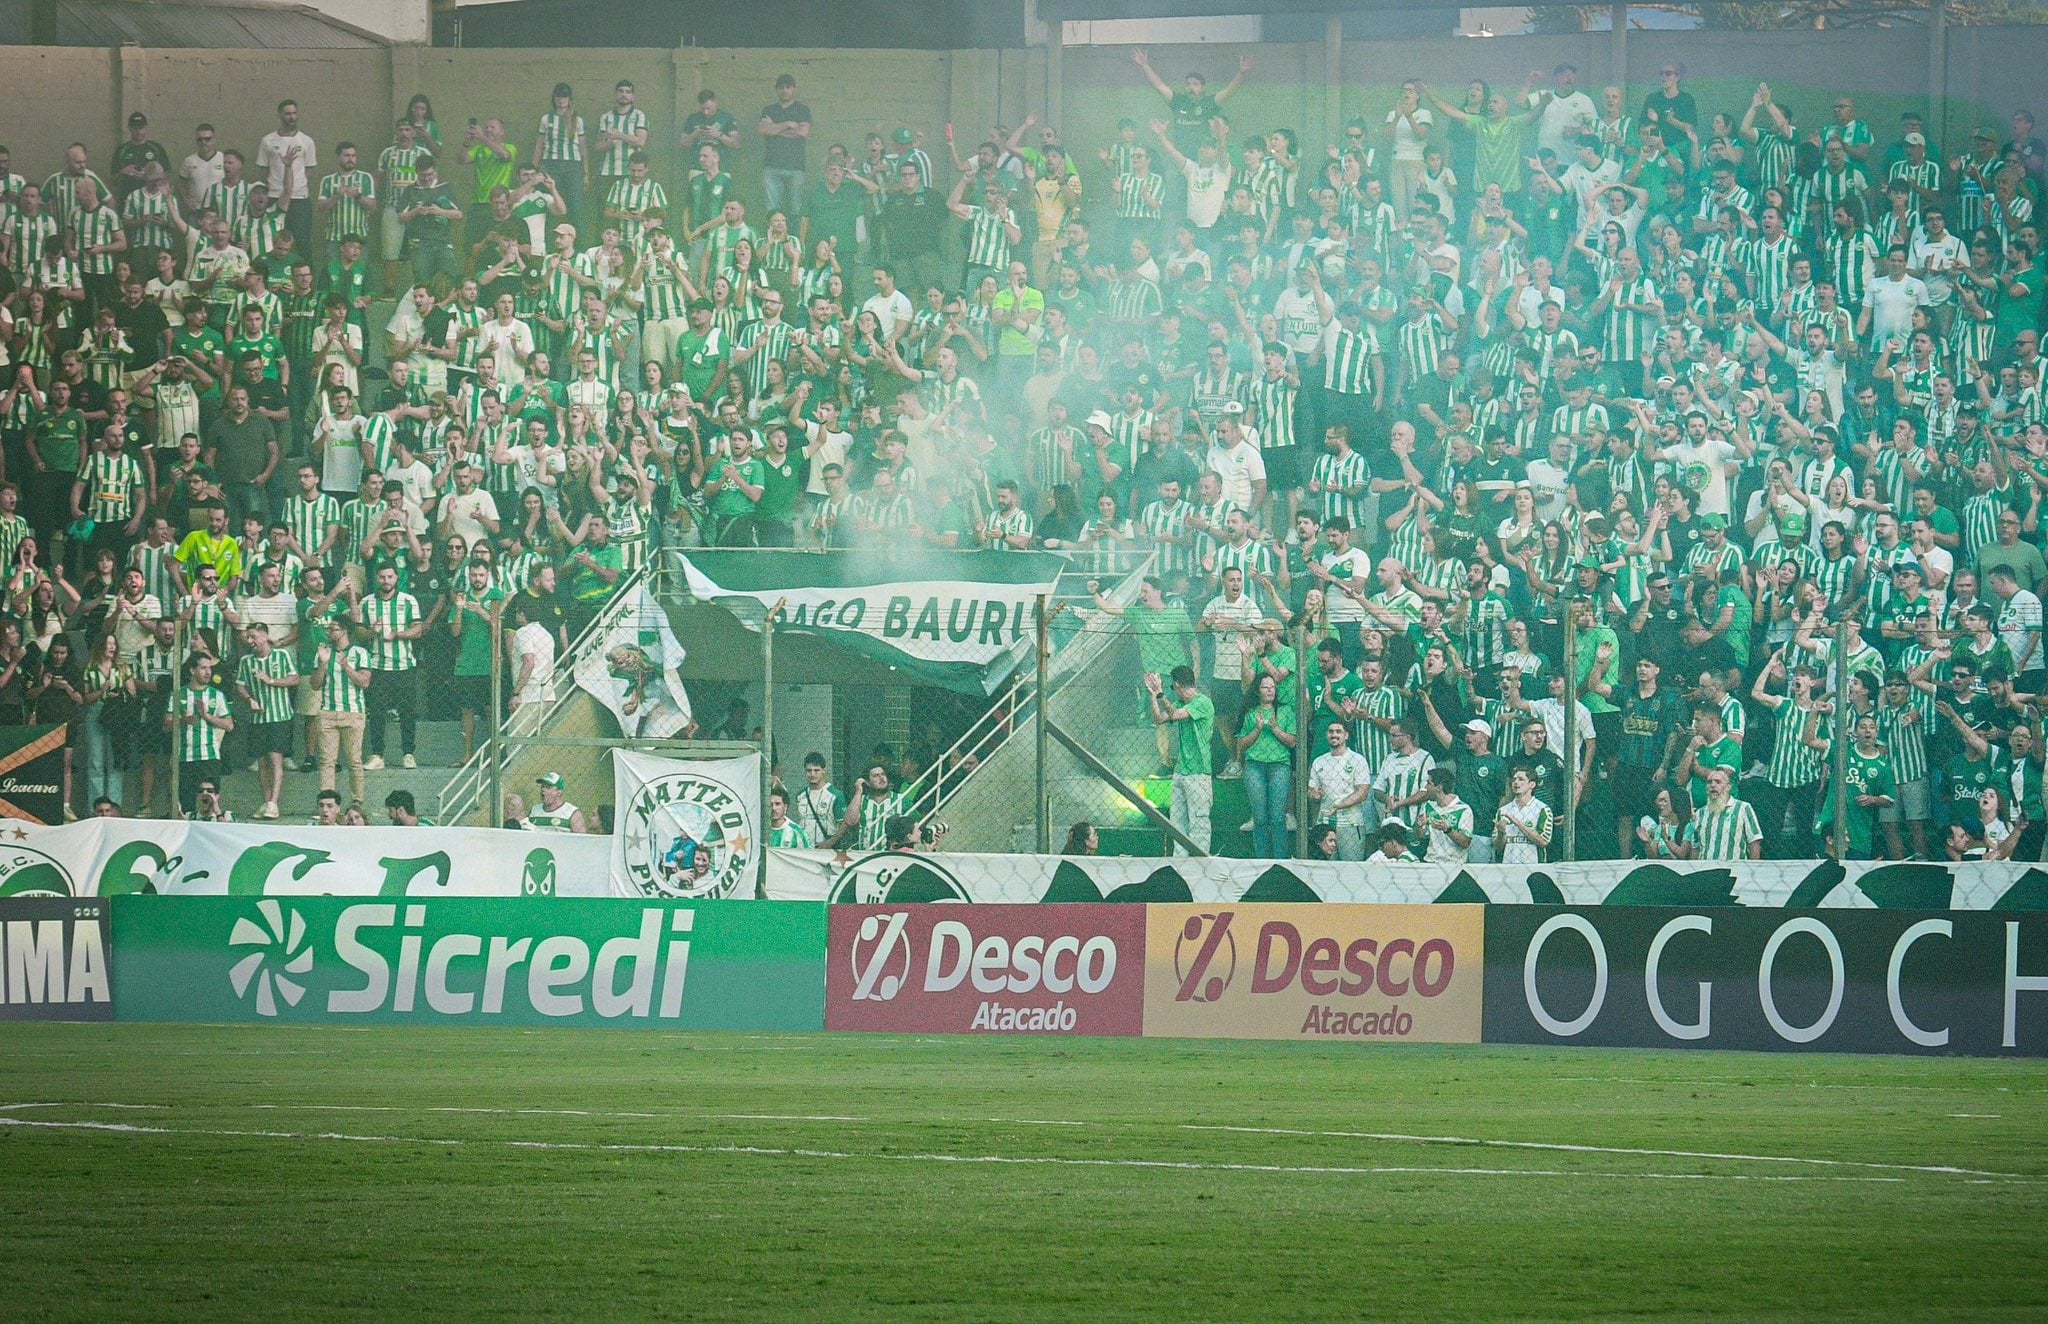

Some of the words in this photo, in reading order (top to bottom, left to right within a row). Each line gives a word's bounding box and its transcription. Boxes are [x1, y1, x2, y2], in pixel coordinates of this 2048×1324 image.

[1536, 484, 1565, 495] Banrisu
[634, 780, 743, 828] MATTEO
[328, 904, 695, 1018] Sicredi
[923, 920, 1117, 994] Desco
[1250, 921, 1456, 998] Desco
[970, 1000, 1078, 1031] Atacado
[1300, 1004, 1414, 1036] Atacado
